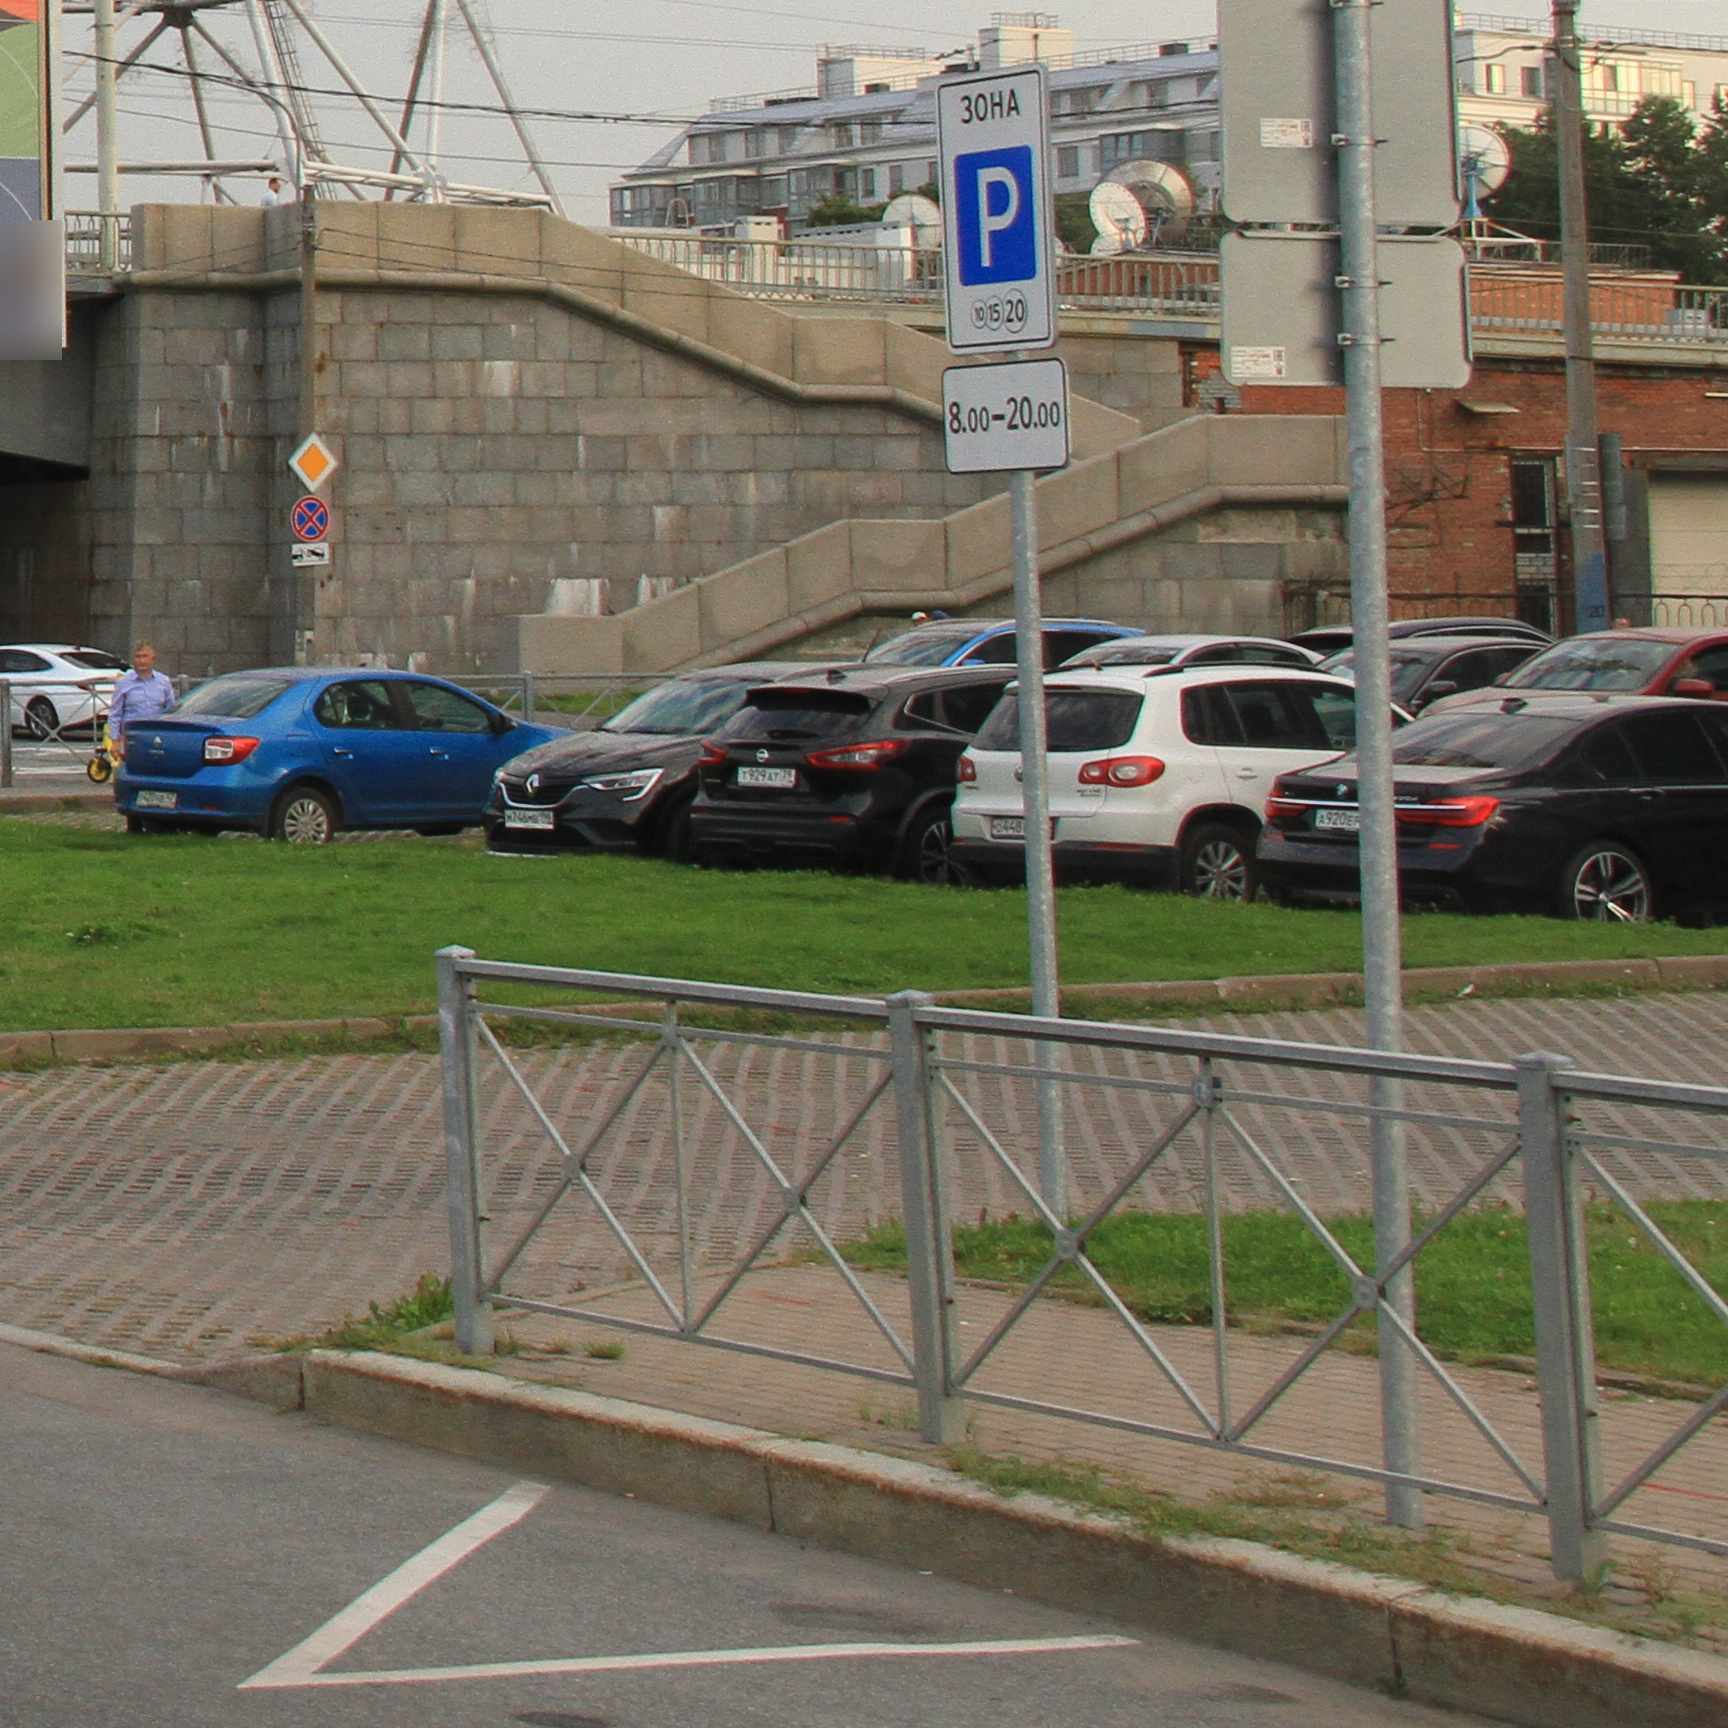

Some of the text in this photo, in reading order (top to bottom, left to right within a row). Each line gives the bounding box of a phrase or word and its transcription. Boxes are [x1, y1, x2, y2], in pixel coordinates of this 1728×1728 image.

[960, 88, 1021, 123] ЗОНА
[1005, 297, 1025, 323] 20
[948, 394, 1060, 435] 8.00-20.00
